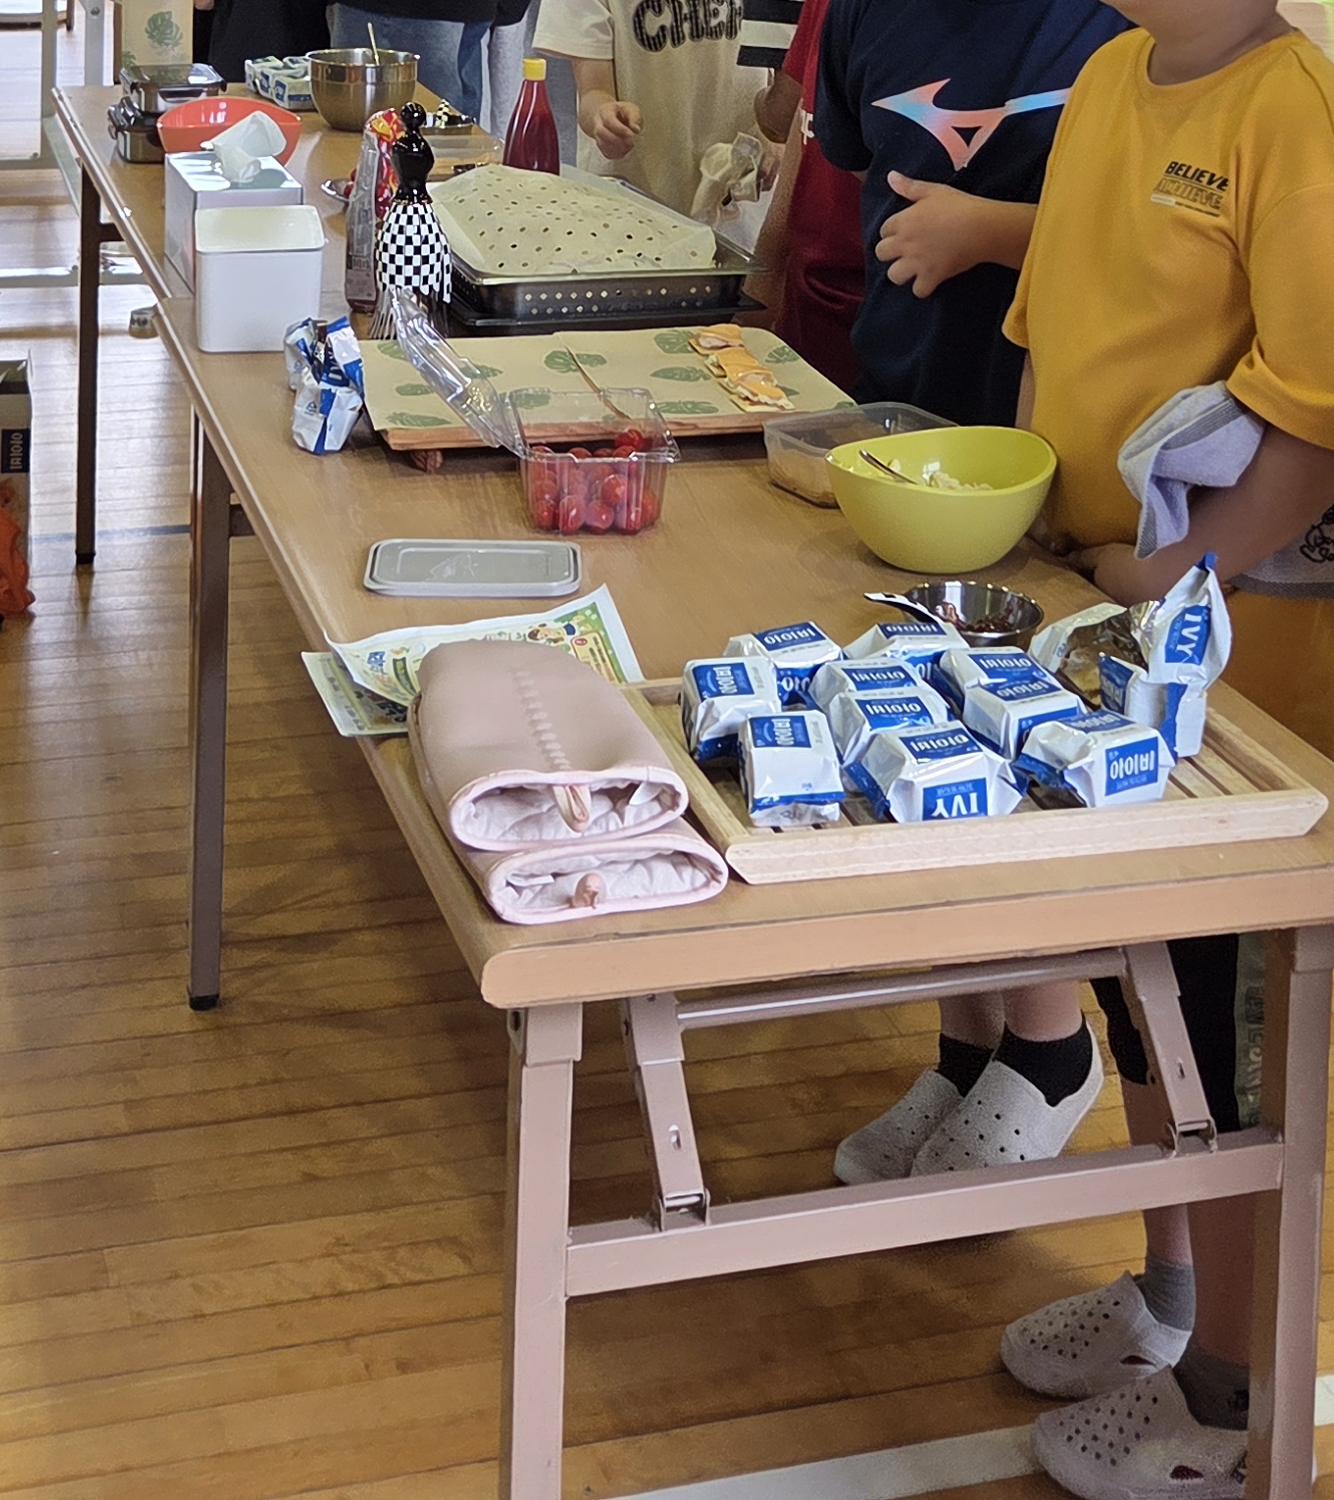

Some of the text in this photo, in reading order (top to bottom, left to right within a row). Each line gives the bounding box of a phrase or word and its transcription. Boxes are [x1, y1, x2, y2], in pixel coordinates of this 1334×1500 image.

[1165, 160, 1230, 192] BELIEVE
[763, 627, 817, 645] 아이비
[885, 623, 938, 634] 아이비
[1176, 612, 1203, 663] IVY
[979, 657, 1032, 670] 아이비
[716, 666, 738, 694] 아이비
[852, 670, 906, 683] 아이비
[996, 680, 1050, 697] 아이비
[866, 701, 922, 716] 아이비
[771, 718, 796, 746] 아이비
[910, 731, 970, 749] 아이비
[1109, 749, 1156, 781] 아이비
[931, 792, 980, 819] IVY
